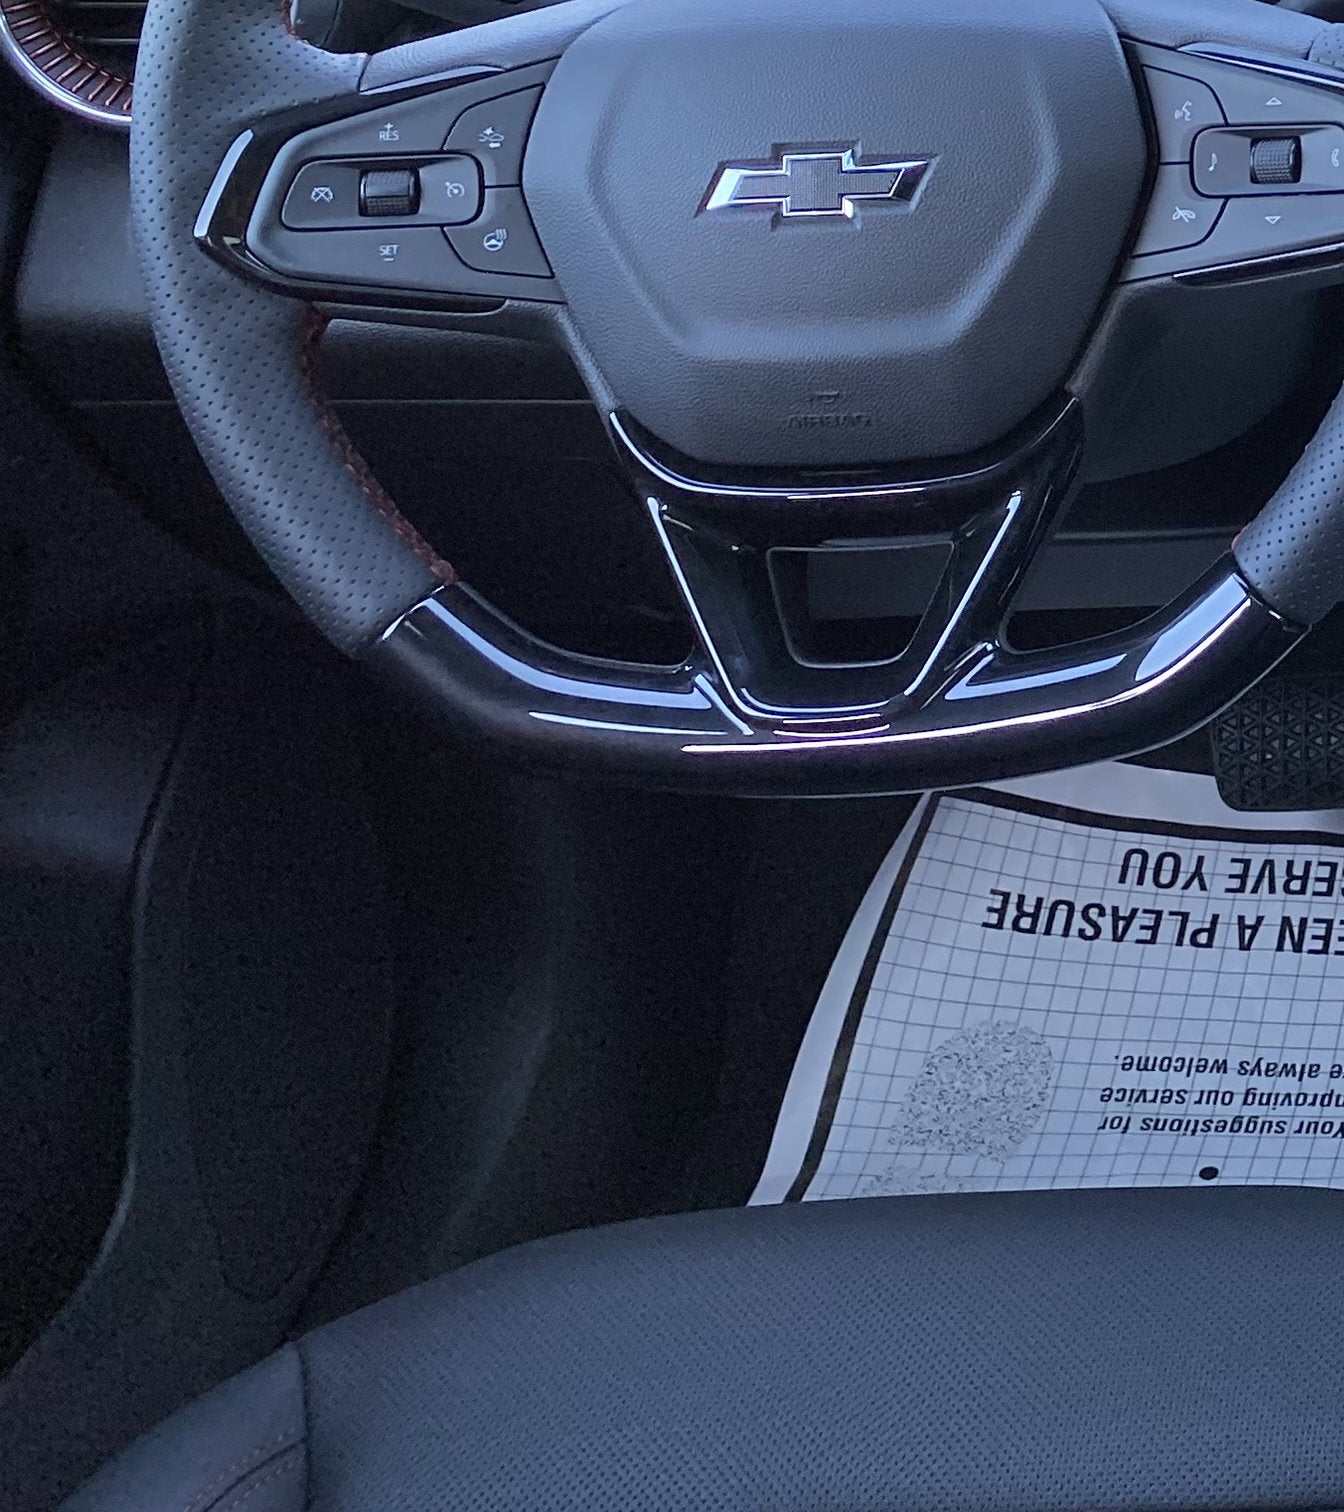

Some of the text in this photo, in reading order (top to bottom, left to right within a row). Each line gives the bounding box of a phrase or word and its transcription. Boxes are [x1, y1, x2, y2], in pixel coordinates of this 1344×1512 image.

[379, 129, 400, 141] RES
[379, 243, 399, 256] SET
[1118, 848, 1209, 891] YOU
[981, 888, 1220, 949] PLEASURE
[1235, 914, 1265, 951] A
[1115, 1053, 1228, 1075] welcome.
[1238, 1058, 1321, 1080] always
[1100, 1086, 1187, 1106] service
[1193, 1090, 1235, 1108] our
[1097, 1114, 1131, 1134] for
[1140, 1113, 1287, 1137] suggestions
